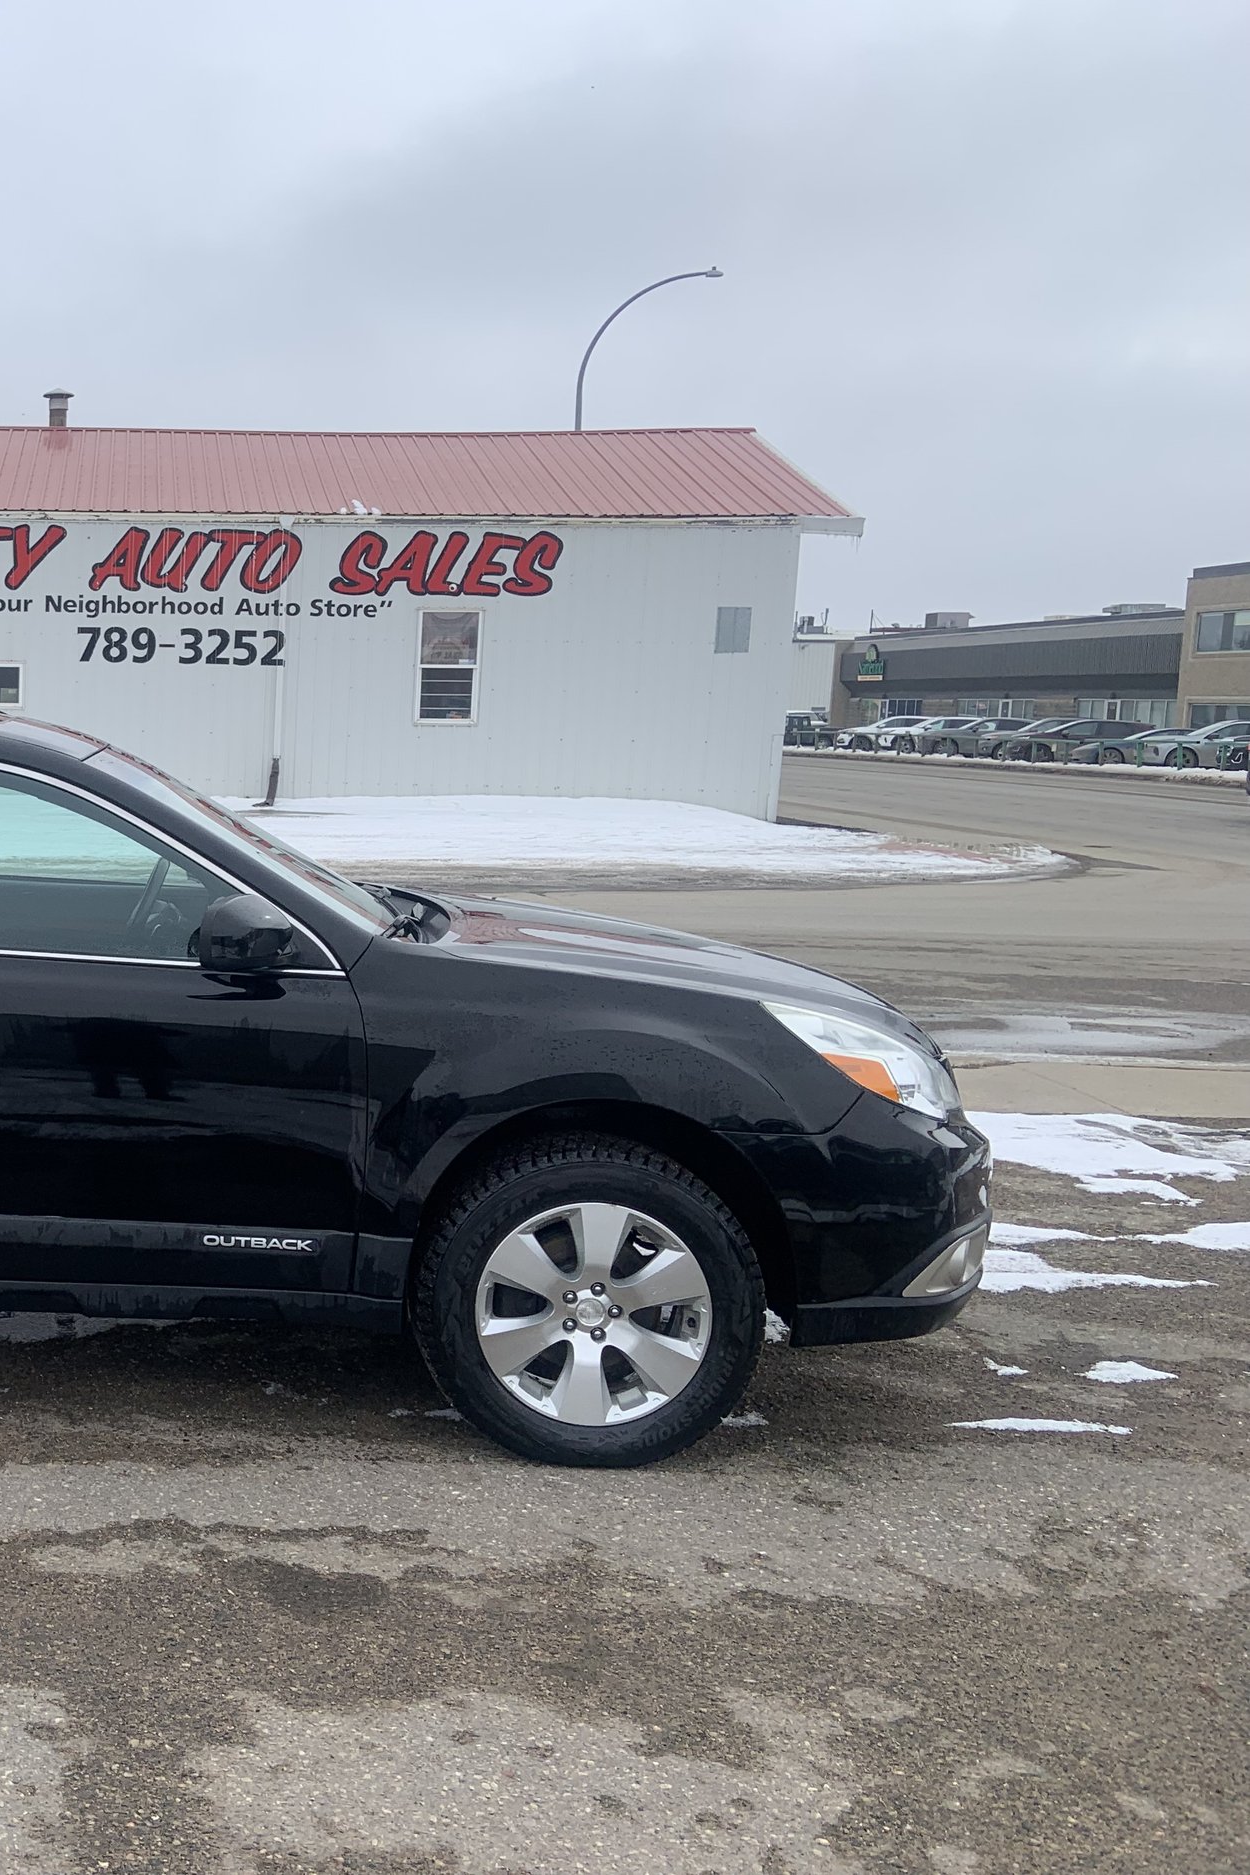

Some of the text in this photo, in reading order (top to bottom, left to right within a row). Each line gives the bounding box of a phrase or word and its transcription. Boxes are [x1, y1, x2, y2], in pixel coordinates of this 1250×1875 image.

[88, 526, 303, 594] AUTO
[330, 530, 563, 597] SALES
[44, 594, 224, 617] Neighborhood
[235, 598, 301, 617] Auto
[77, 626, 285, 667] 789-3252
[203, 1235, 313, 1252] OUTBACK
